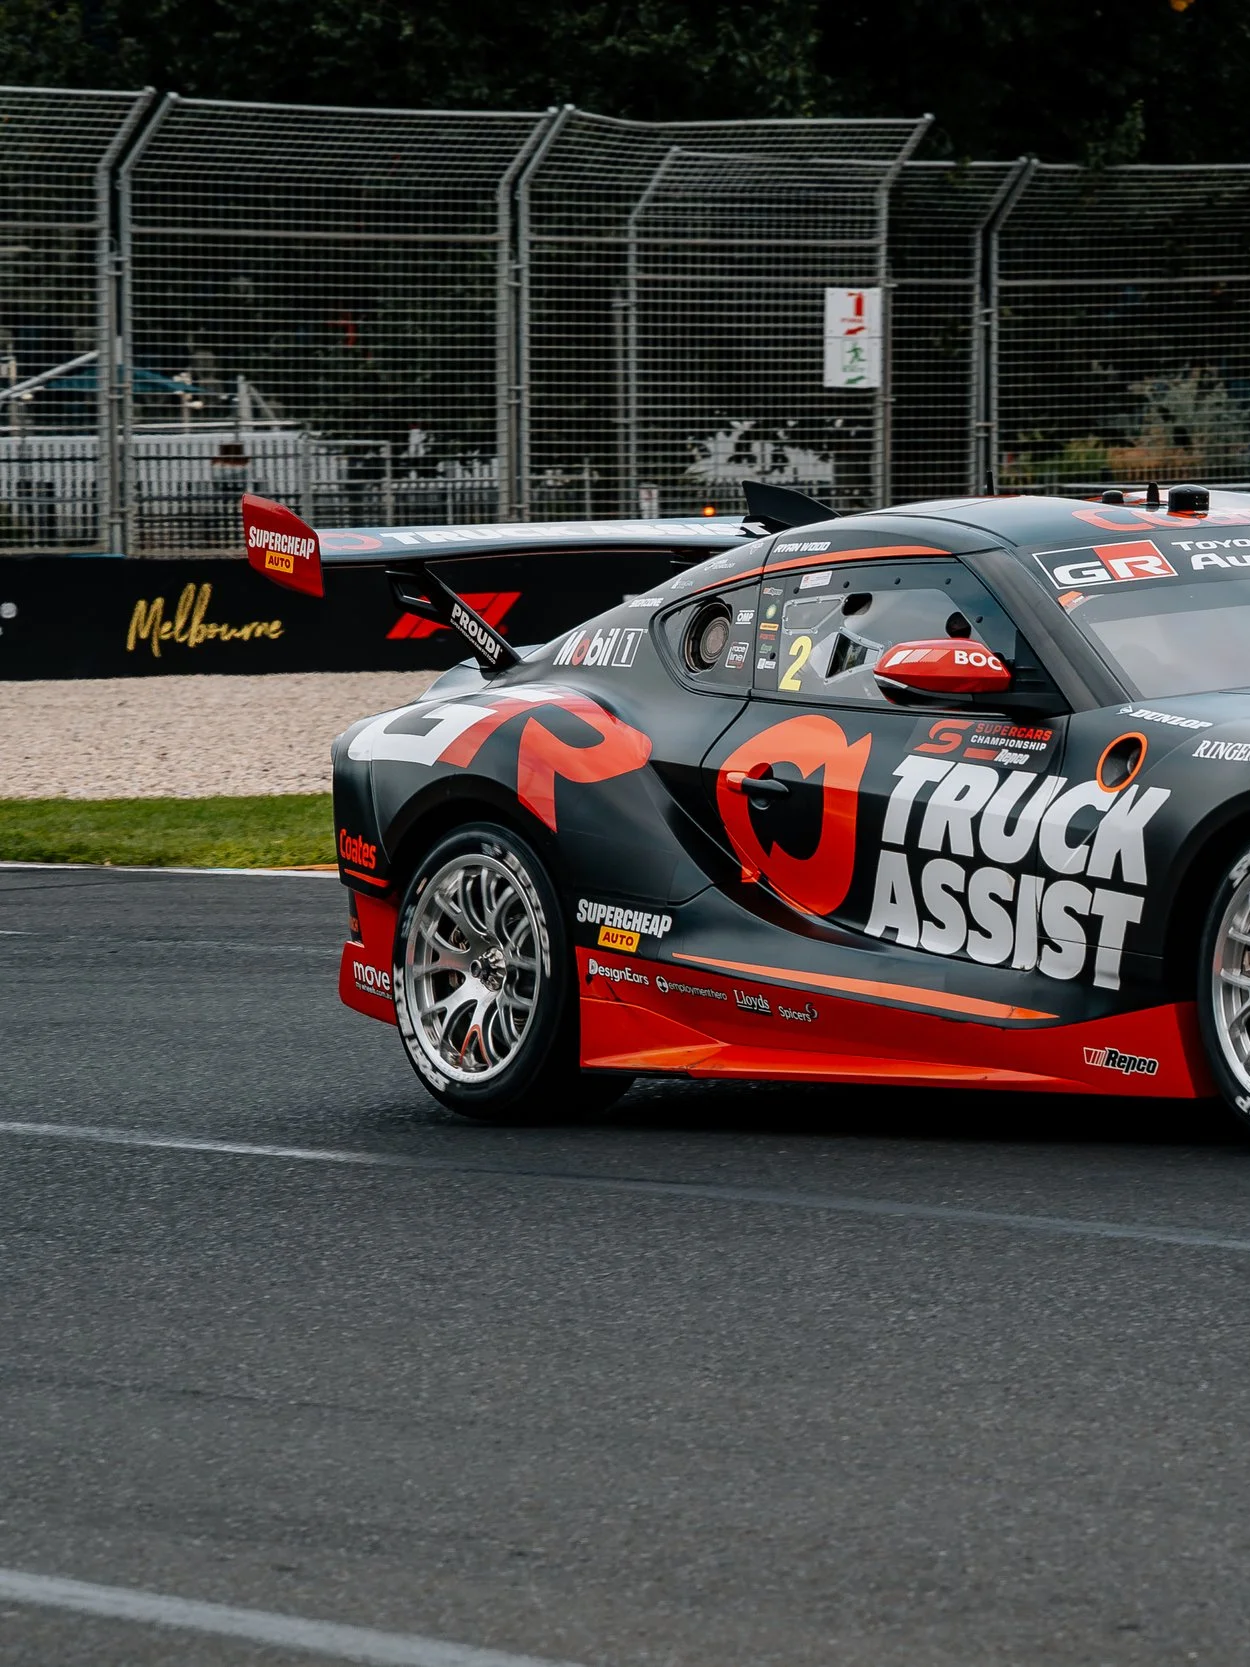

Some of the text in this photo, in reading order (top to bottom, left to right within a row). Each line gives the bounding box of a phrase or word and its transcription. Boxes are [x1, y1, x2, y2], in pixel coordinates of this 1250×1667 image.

[248, 525, 315, 560] SUPERCHEAP
[380, 522, 771, 545] TRUCK ASSIST
[774, 543, 801, 553] RYAN
[800, 541, 831, 552] WOOD
[268, 554, 291, 569] AUTO
[1053, 554, 1172, 585] GR
[126, 582, 285, 657] Melbourne
[451, 602, 501, 659] PROUDI
[552, 628, 621, 667] Mobil
[954, 649, 1003, 672] BOC
[779, 635, 812, 691] 2
[975, 723, 1053, 741] SUPERCARS
[1129, 708, 1214, 730] DUNLOP
[970, 734, 1047, 751] CHAMPIONSHIP
[994, 748, 1030, 766] Repco
[881, 753, 1172, 886] TRUCK
[339, 828, 376, 870] Coates
[576, 898, 673, 938] SUPERCHEAP
[863, 849, 1145, 991] ASSIST
[602, 931, 635, 947] AUTO
[353, 961, 391, 991] move
[588, 958, 650, 985] DesignEars
[733, 989, 771, 1011] Lloyds
[778, 1005, 812, 1022] Spicers
[1103, 1047, 1159, 1075] Repco
